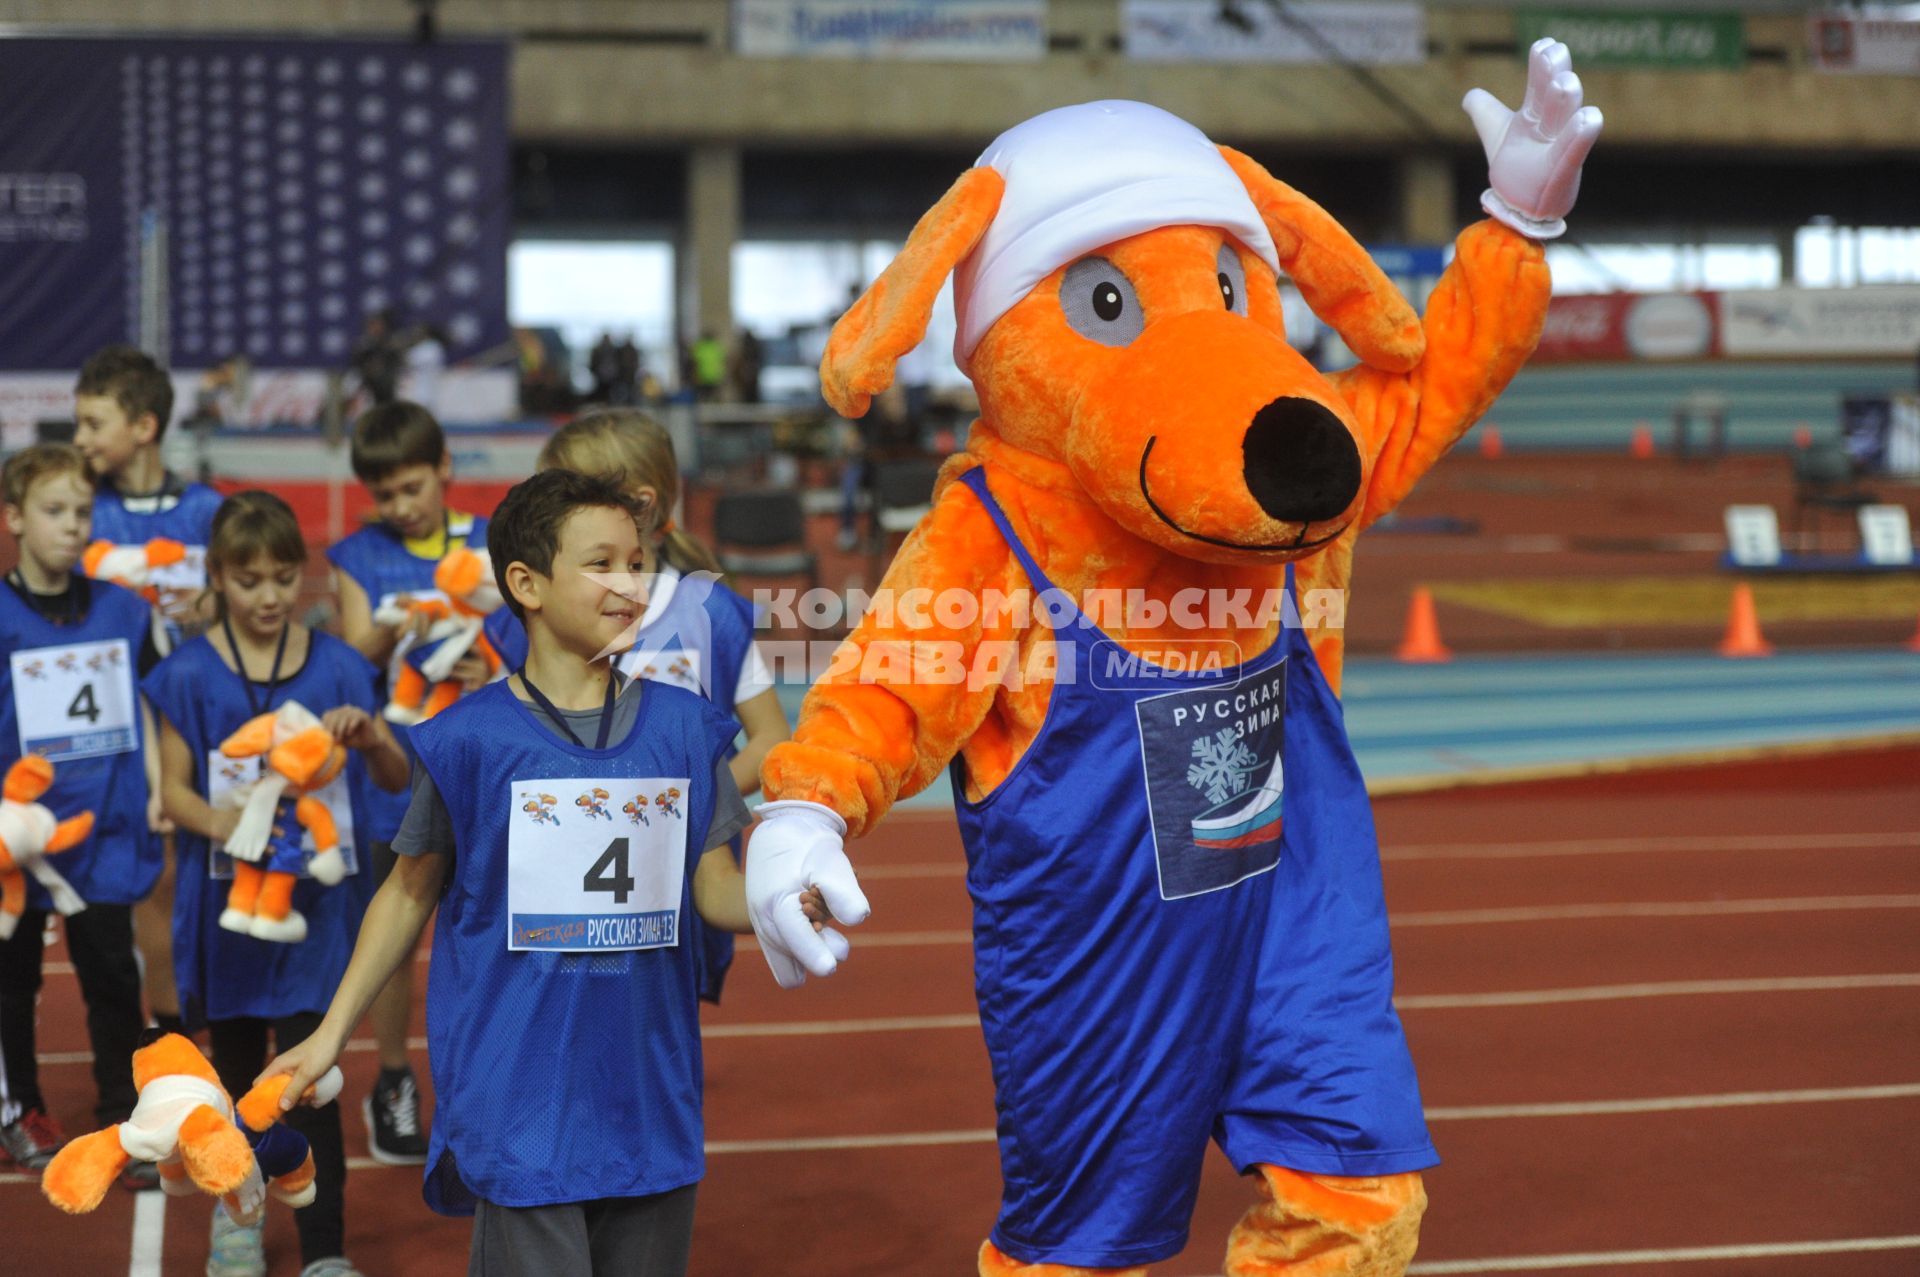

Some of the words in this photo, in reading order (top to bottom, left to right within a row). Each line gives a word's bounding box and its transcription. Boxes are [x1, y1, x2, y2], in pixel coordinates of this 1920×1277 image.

[67, 683, 101, 723] 4
[1173, 678, 1280, 727] РУССКАЯ
[1234, 703, 1280, 739] ЗИМА
[583, 837, 635, 904] 4
[587, 917, 637, 946] РУССКАЯ
